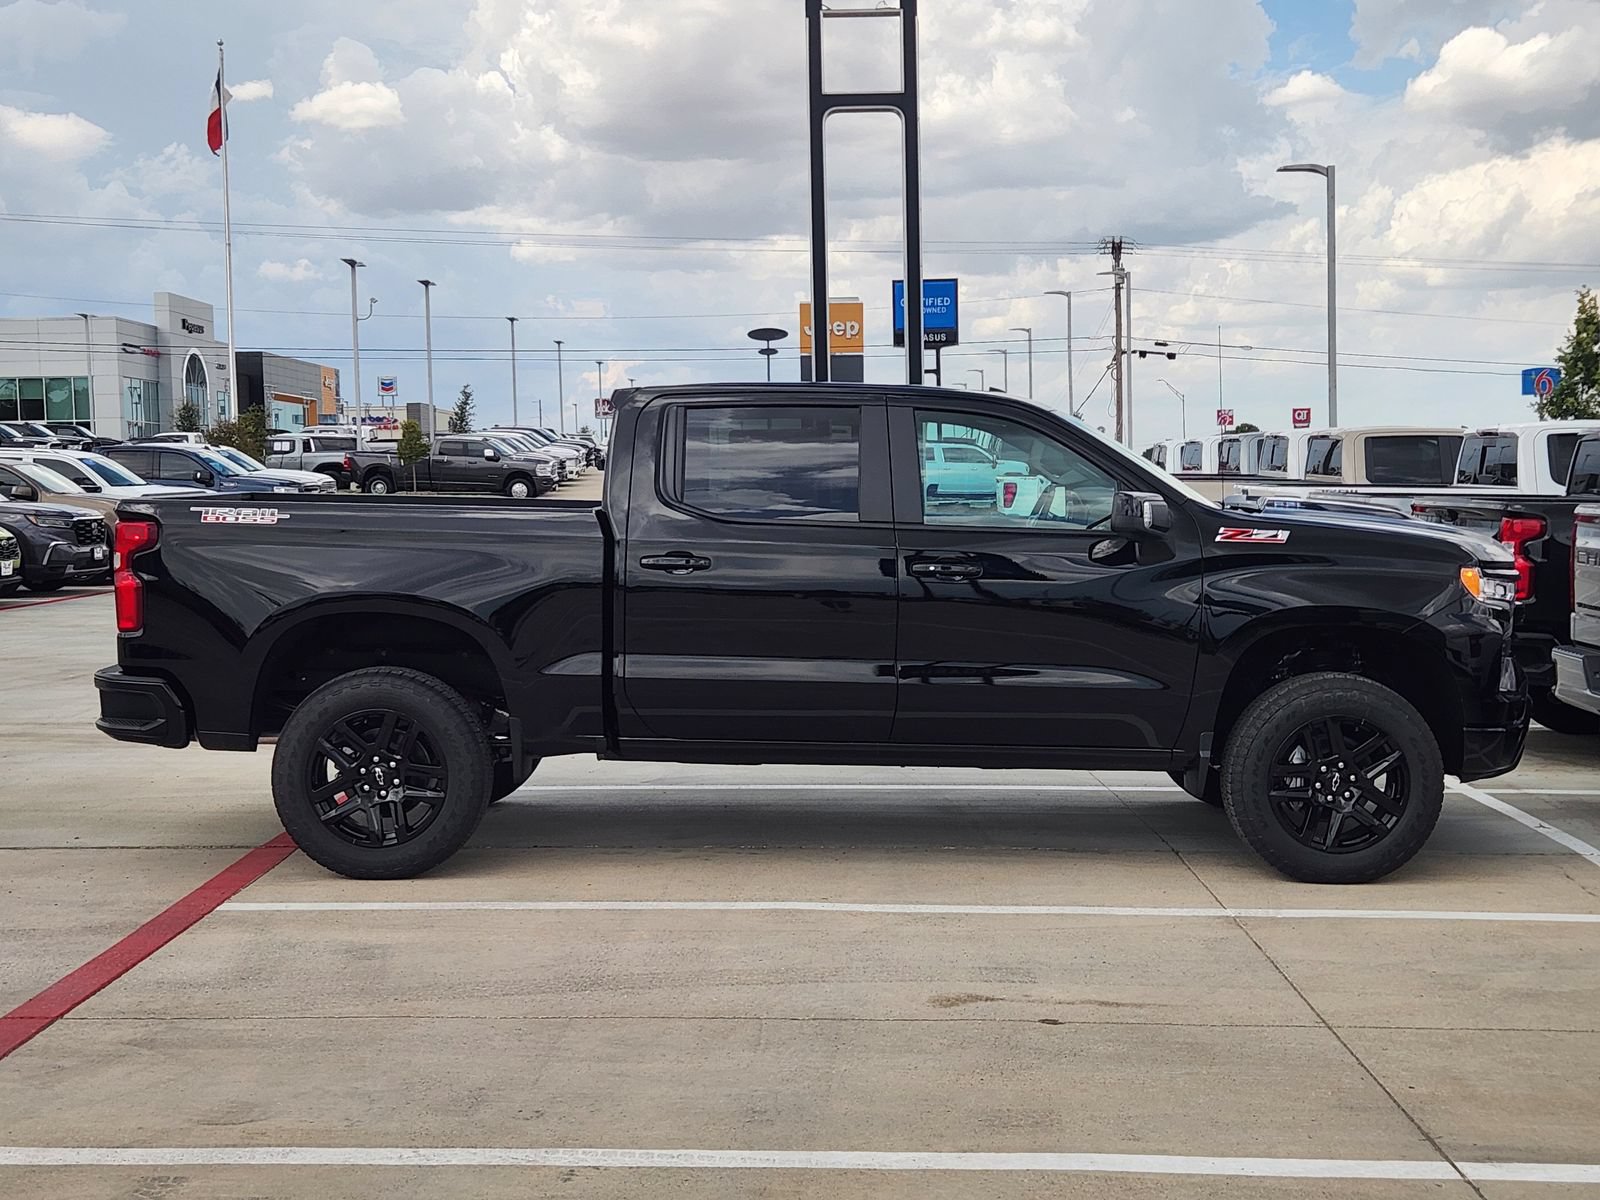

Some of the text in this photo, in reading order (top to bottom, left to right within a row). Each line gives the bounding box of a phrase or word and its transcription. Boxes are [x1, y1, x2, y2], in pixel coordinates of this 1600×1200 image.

[803, 320, 860, 339] Jep
[1535, 368, 1554, 397] 6
[1294, 410, 1309, 421] QT
[190, 506, 290, 517] TRAIL
[201, 514, 278, 525] BOSS
[1215, 526, 1291, 544] Z71
